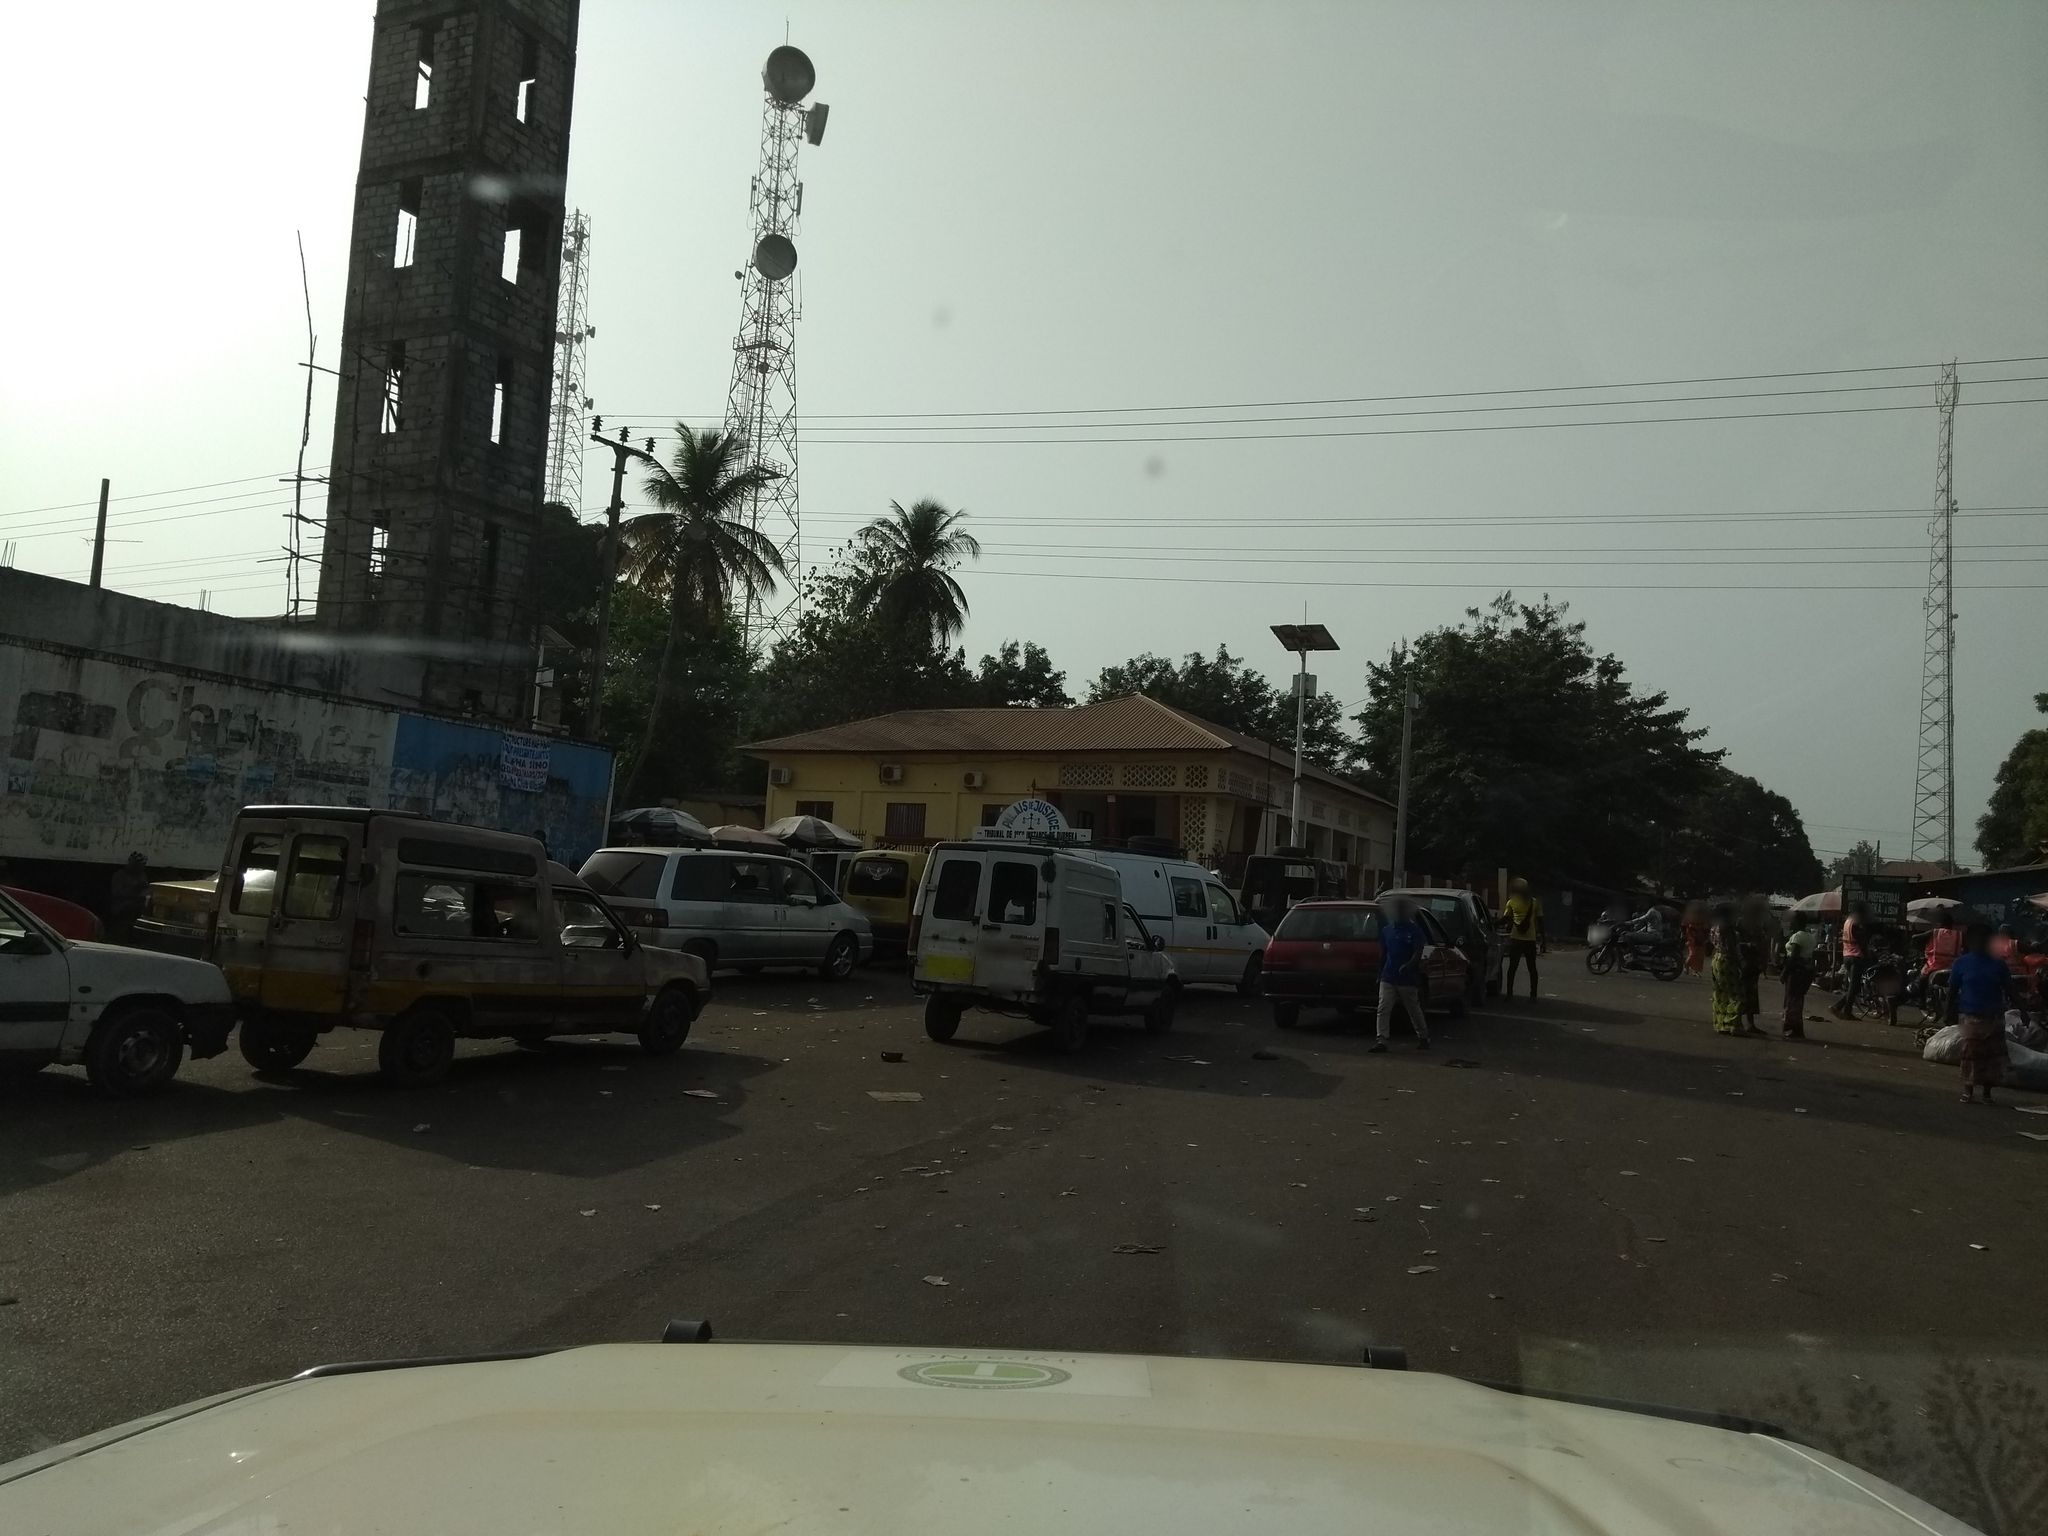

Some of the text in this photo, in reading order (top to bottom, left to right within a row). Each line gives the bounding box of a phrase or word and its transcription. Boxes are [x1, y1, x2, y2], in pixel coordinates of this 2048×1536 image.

[1002, 801, 1028, 829] PALAIS
[1033, 800, 1060, 831] JUSTICE
[984, 829, 1004, 838] TRIBUNAL
